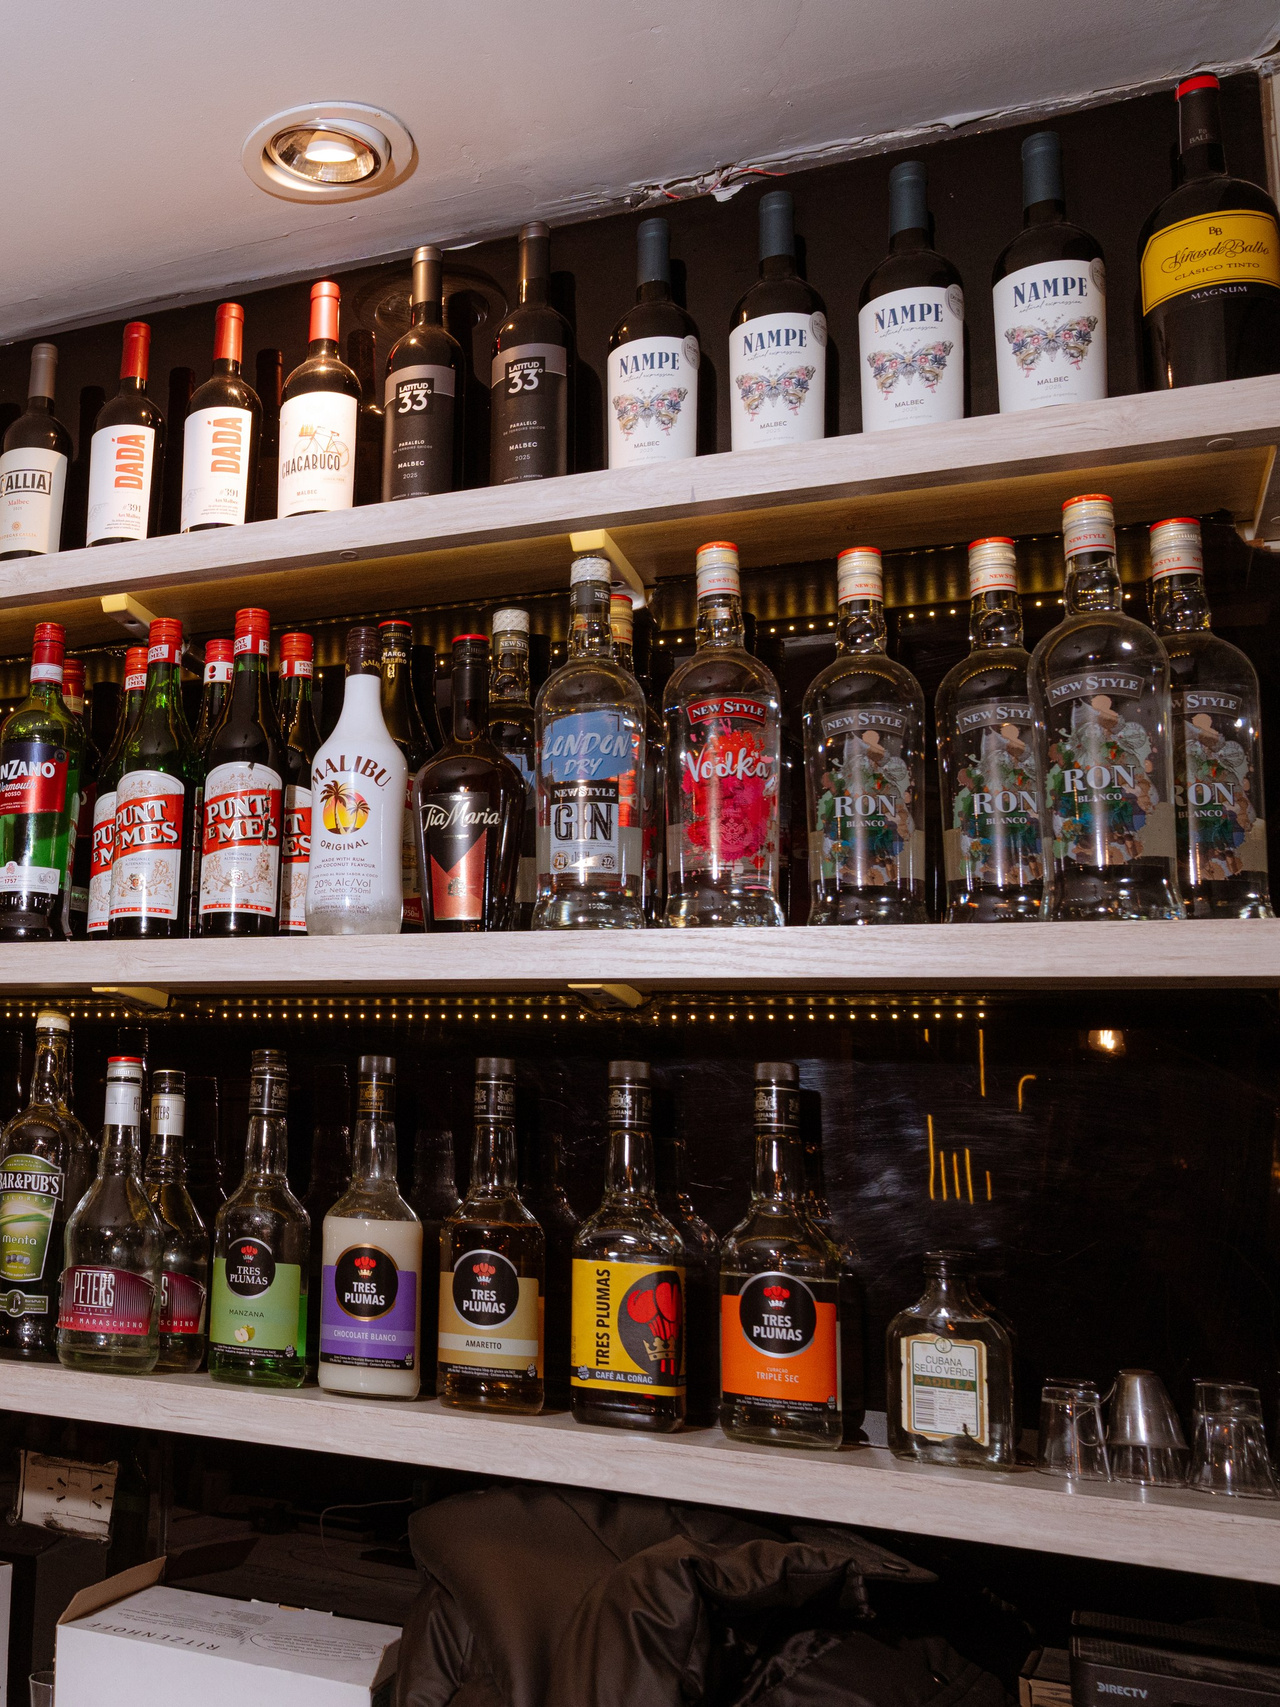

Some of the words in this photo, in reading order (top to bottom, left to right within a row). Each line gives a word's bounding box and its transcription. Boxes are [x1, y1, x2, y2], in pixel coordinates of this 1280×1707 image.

[1175, 263, 1224, 281] CLÁSICO
[1013, 277, 1088, 307] NAMPE
[1190, 286, 1248, 300] MAGNUM
[875, 303, 943, 333] NAMPE
[743, 329, 807, 355] NAMPE
[509, 361, 539, 373] LATITUD
[620, 351, 680, 377] NAMPE
[399, 383, 428, 392] LATITUD
[1037, 376, 1069, 386] MALBEC
[895, 399, 924, 408] MALBEC
[510, 420, 537, 428] PARALELO
[760, 420, 787, 429] MALBEC
[207, 417, 242, 474] DADÁ
[509, 442, 537, 451] MALBEC
[111, 434, 145, 490] DADÁ
[281, 454, 340, 479] CHACABUCO
[398, 460, 425, 469] MALBEC
[0, 474, 46, 493] CALLIA
[1051, 681, 1084, 699] NEW
[1086, 676, 1139, 692] STYLE
[1187, 695, 1237, 710] STYLE
[692, 705, 722, 718] NEW
[723, 702, 764, 717] STYLE
[827, 715, 856, 730] NEW
[858, 712, 903, 729] STYLE
[963, 710, 995, 726] NEW
[542, 732, 631, 760] LONDON
[564, 758, 603, 777] DRY
[687, 748, 769, 782] Vodka
[312, 754, 392, 791] MALIBU
[1062, 765, 1135, 795] RON
[553, 788, 578, 799] NEW
[578, 786, 616, 798] STYLE
[1078, 792, 1123, 804] BLANCO
[207, 795, 266, 825] PUNT
[834, 795, 897, 819] RON
[972, 791, 1038, 816] RON
[115, 799, 167, 832] PUNT
[442, 802, 501, 830] Maria
[554, 802, 613, 841] GIN
[986, 816, 1028, 826] BLANCO
[208, 828, 216, 839] E
[217, 817, 278, 842] MES
[846, 818, 885, 828] BLANCO
[121, 821, 179, 850] MES
[320, 839, 369, 850] ORIGINAL
[314, 879, 332, 888] 20%
[335, 878, 371, 888] Alc/Vol
[350, 886, 372, 894] 750ml
[2, 1195, 46, 1204] LICORES
[2, 1234, 37, 1246] menta
[237, 1265, 260, 1276] TRES
[230, 1274, 268, 1286] PLUMAS
[73, 1271, 115, 1306] PETERS
[353, 1282, 376, 1293] TRES
[345, 1293, 385, 1306] PLUMAS
[471, 1289, 496, 1301] TRES
[596, 1268, 610, 1328] PLUMAS
[229, 1308, 265, 1318] MANZANA
[463, 1300, 506, 1314] PLUMAS
[79, 1318, 143, 1329] MARASCHINO
[762, 1314, 792, 1327] TRES
[333, 1329, 368, 1340] CHOCOLATE
[370, 1332, 396, 1342] BLANCO
[753, 1326, 803, 1342] PLUMAS
[465, 1340, 502, 1350] AMARETTO
[596, 1332, 610, 1366] TRES
[926, 1355, 962, 1366] CUBANA
[596, 1370, 614, 1380] CAFÉ
[616, 1373, 626, 1381] AL
[627, 1373, 653, 1384] COÑAC
[756, 1371, 785, 1382] TRIPLE
[786, 1373, 799, 1383] SEC
[914, 1363, 942, 1374] SELLO
[944, 1366, 974, 1377] VERDE
[1096, 1682, 1147, 1699] DIRECTV
